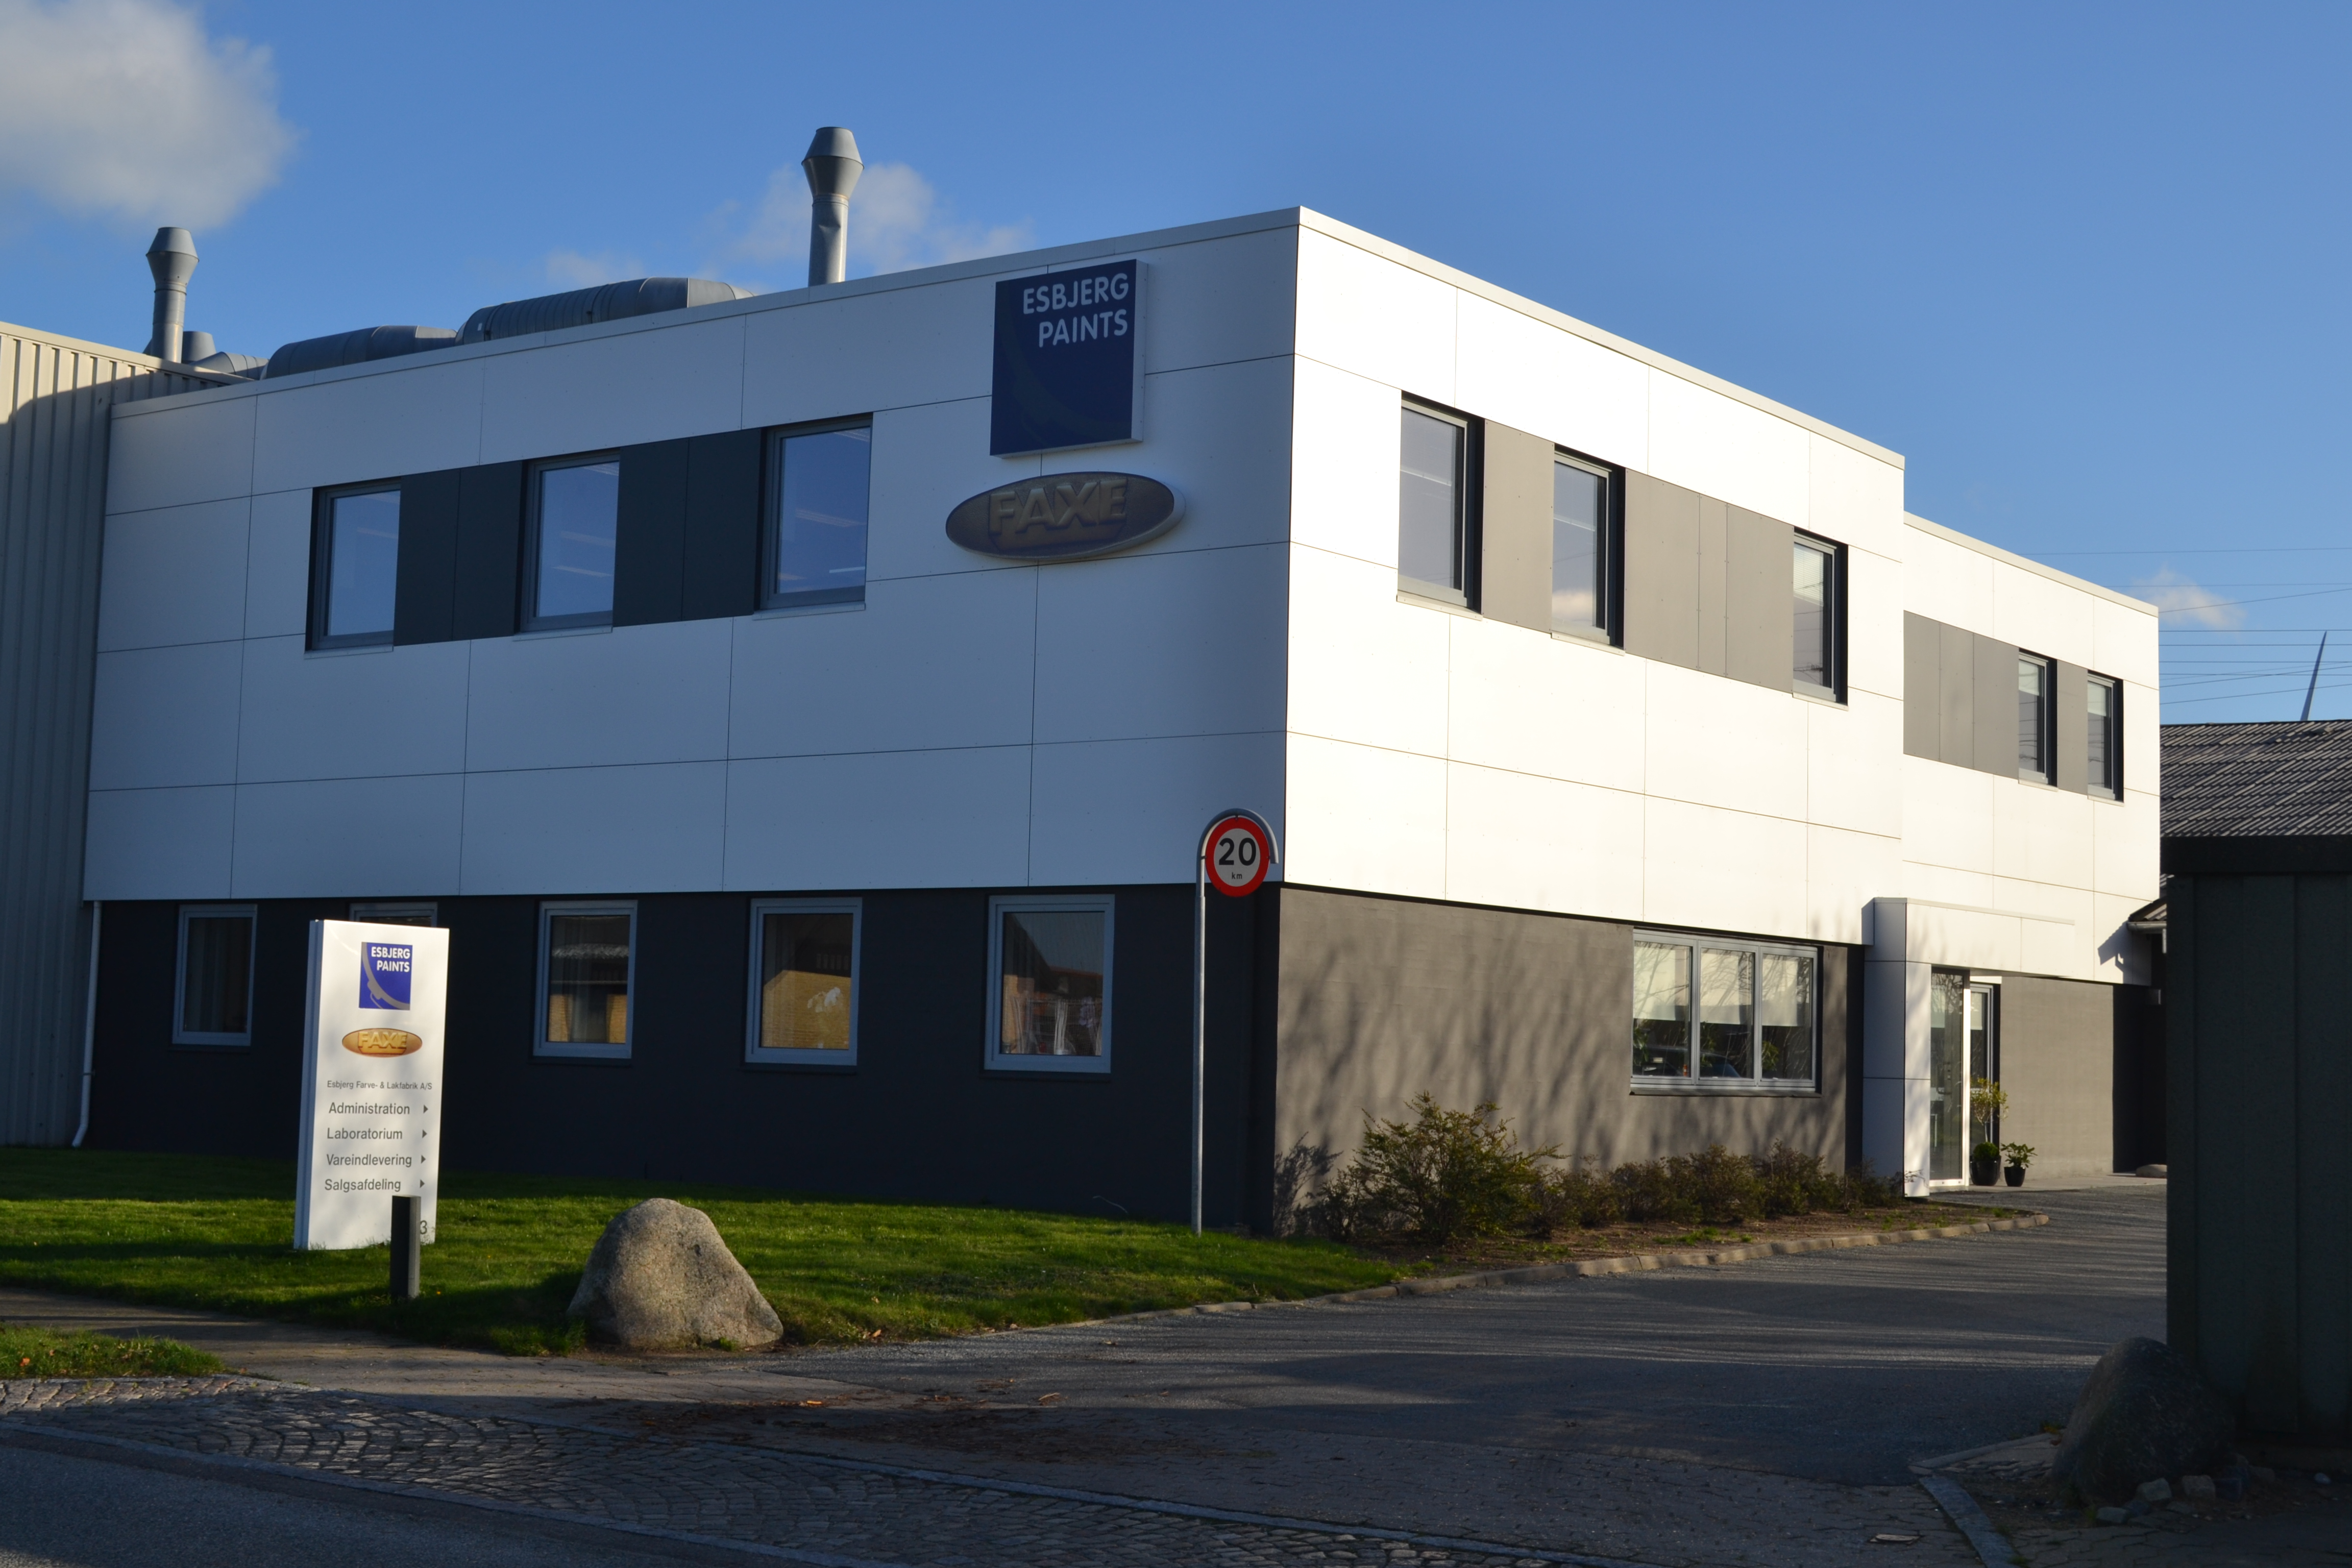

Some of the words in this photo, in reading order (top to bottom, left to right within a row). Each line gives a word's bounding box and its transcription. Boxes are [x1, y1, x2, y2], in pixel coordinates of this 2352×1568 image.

[1022, 273, 1129, 315] ESBJERG
[1038, 309, 1128, 348] PAINTS
[988, 477, 1128, 537] FAXE
[1218, 837, 1257, 866] 20
[371, 946, 411, 959] ESBJERG
[377, 960, 410, 973] PAINTS
[358, 1032, 408, 1049] FAXE
[327, 1080, 354, 1090] Esbjerg
[356, 1081, 378, 1089] Farve-
[387, 1082, 418, 1090] Lakfabrik
[328, 1102, 410, 1115] Administration
[327, 1127, 403, 1140] Laboratorium
[326, 1154, 412, 1168] Vareindlevering
[324, 1178, 401, 1193] Salgsafdeling
